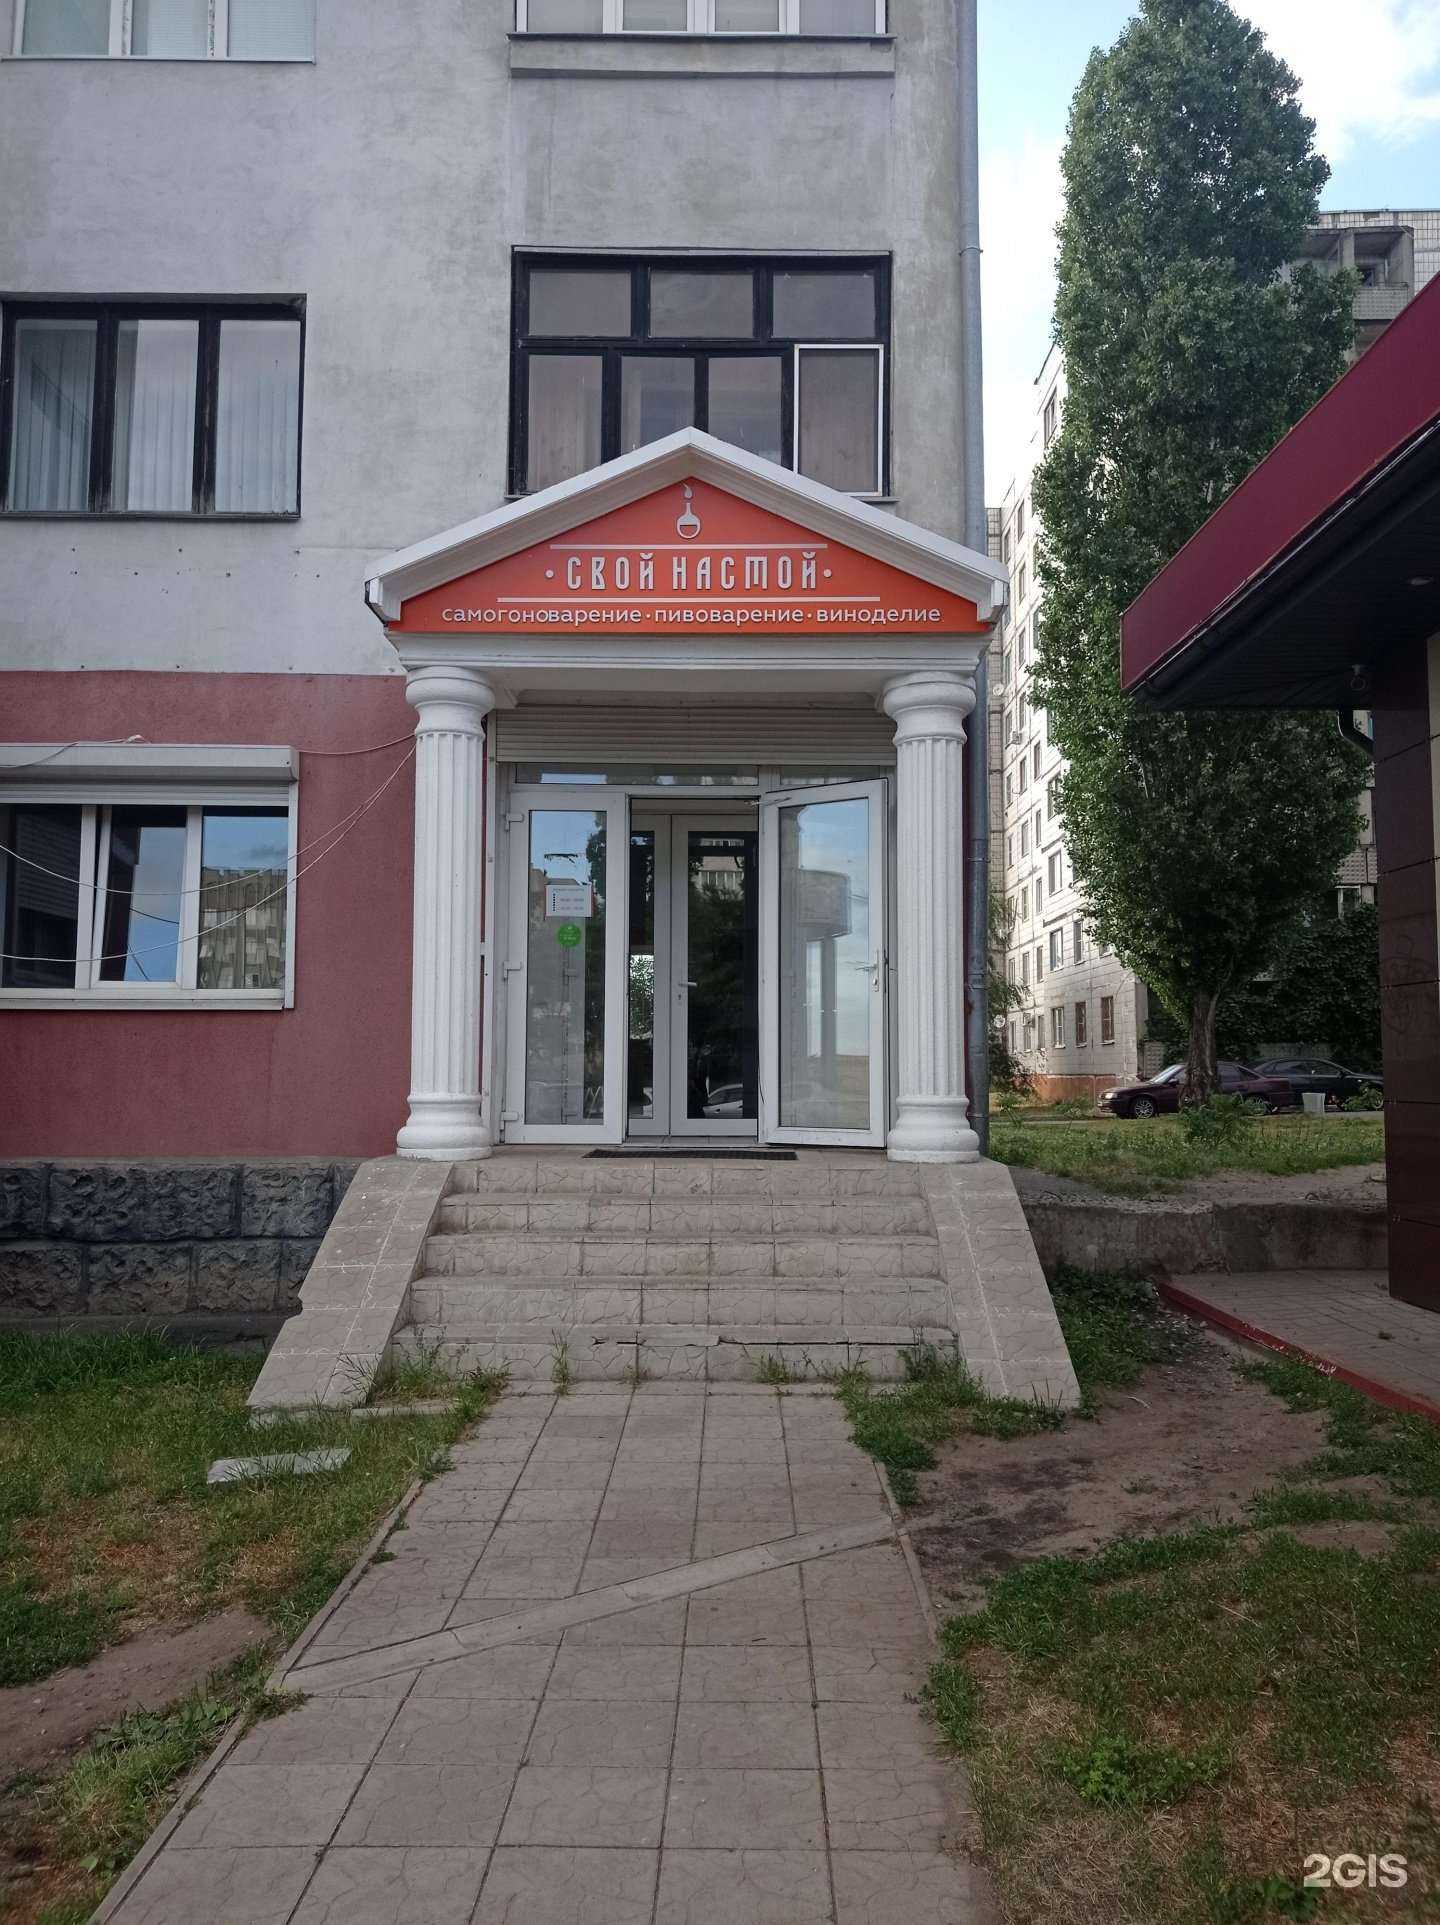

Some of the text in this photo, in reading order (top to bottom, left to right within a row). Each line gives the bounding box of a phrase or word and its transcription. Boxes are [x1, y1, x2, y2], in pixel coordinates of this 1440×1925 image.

[567, 551, 816, 590] СВОЙ НАСТОЙ
[441, 605, 941, 626] самогоноварение пивоварение виноделие
